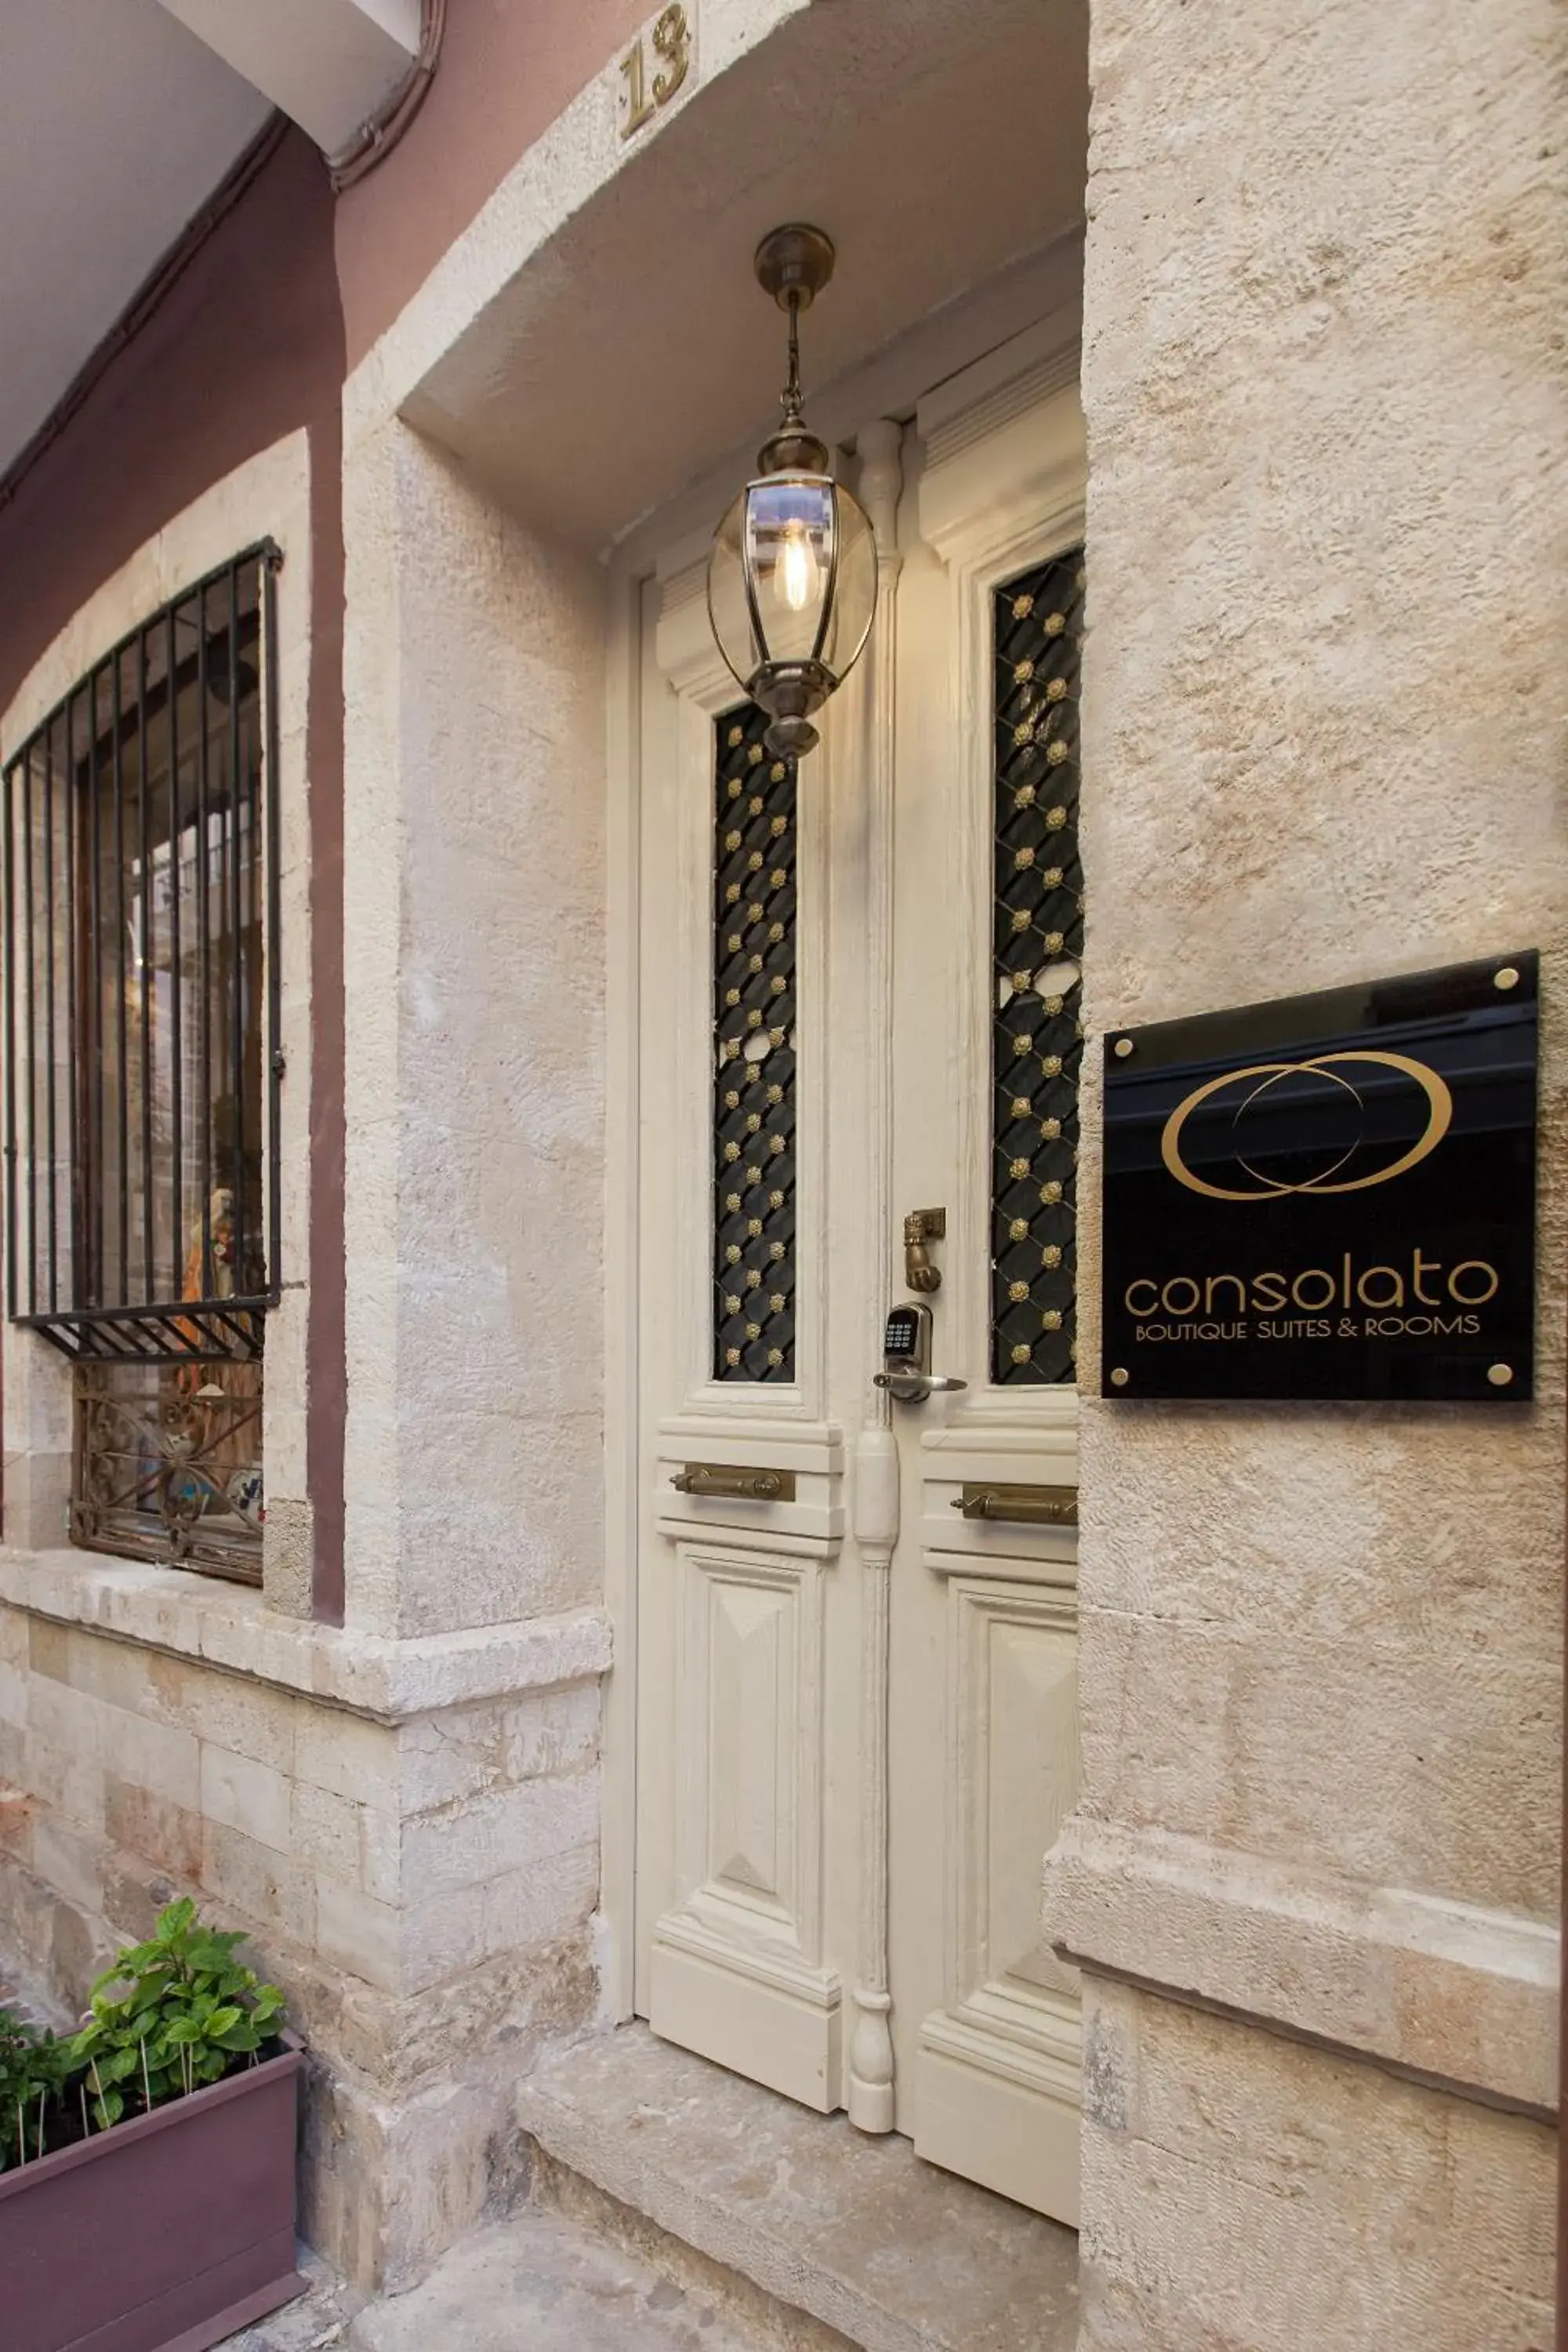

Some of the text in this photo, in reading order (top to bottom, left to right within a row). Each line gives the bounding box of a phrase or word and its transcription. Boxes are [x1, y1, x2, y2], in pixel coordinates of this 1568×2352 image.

[1125, 1247, 1498, 1316] consolato
[1136, 1315, 1481, 1341] BOUTIQUE SUITES & ROOMS
